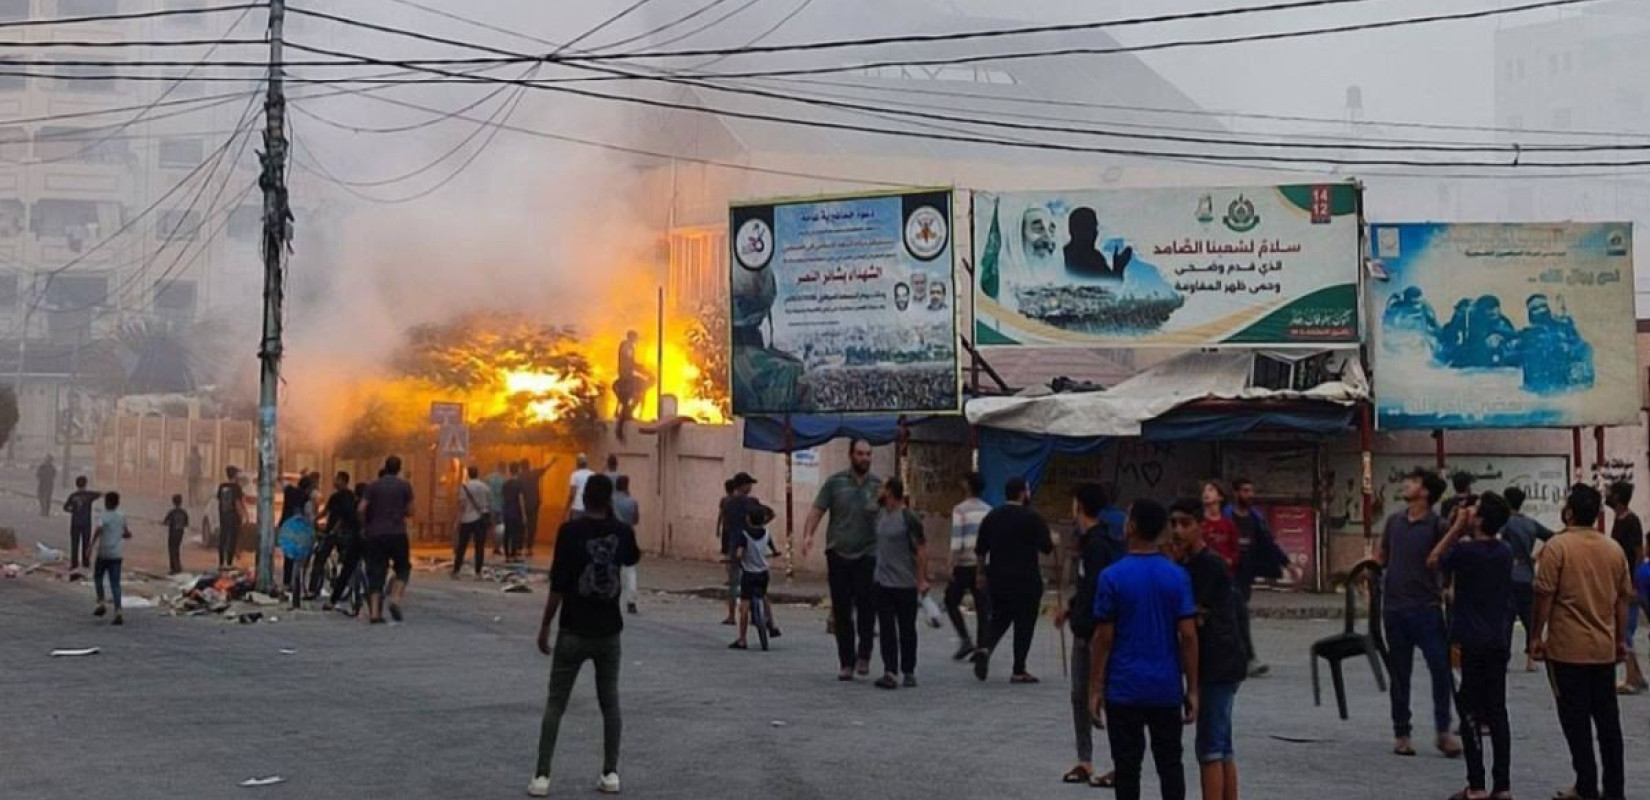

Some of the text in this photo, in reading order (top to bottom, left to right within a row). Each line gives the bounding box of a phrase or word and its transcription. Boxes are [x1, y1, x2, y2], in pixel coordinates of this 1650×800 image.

[1312, 189, 1329, 199] 14
[1312, 204, 1329, 215] 12
[1206, 239, 1254, 257] لشعبنا
[1227, 261, 1256, 274] قدم
[1258, 259, 1283, 276] الذي
[1174, 279, 1222, 294] المقاومة
[1225, 278, 1246, 294] ظهر
